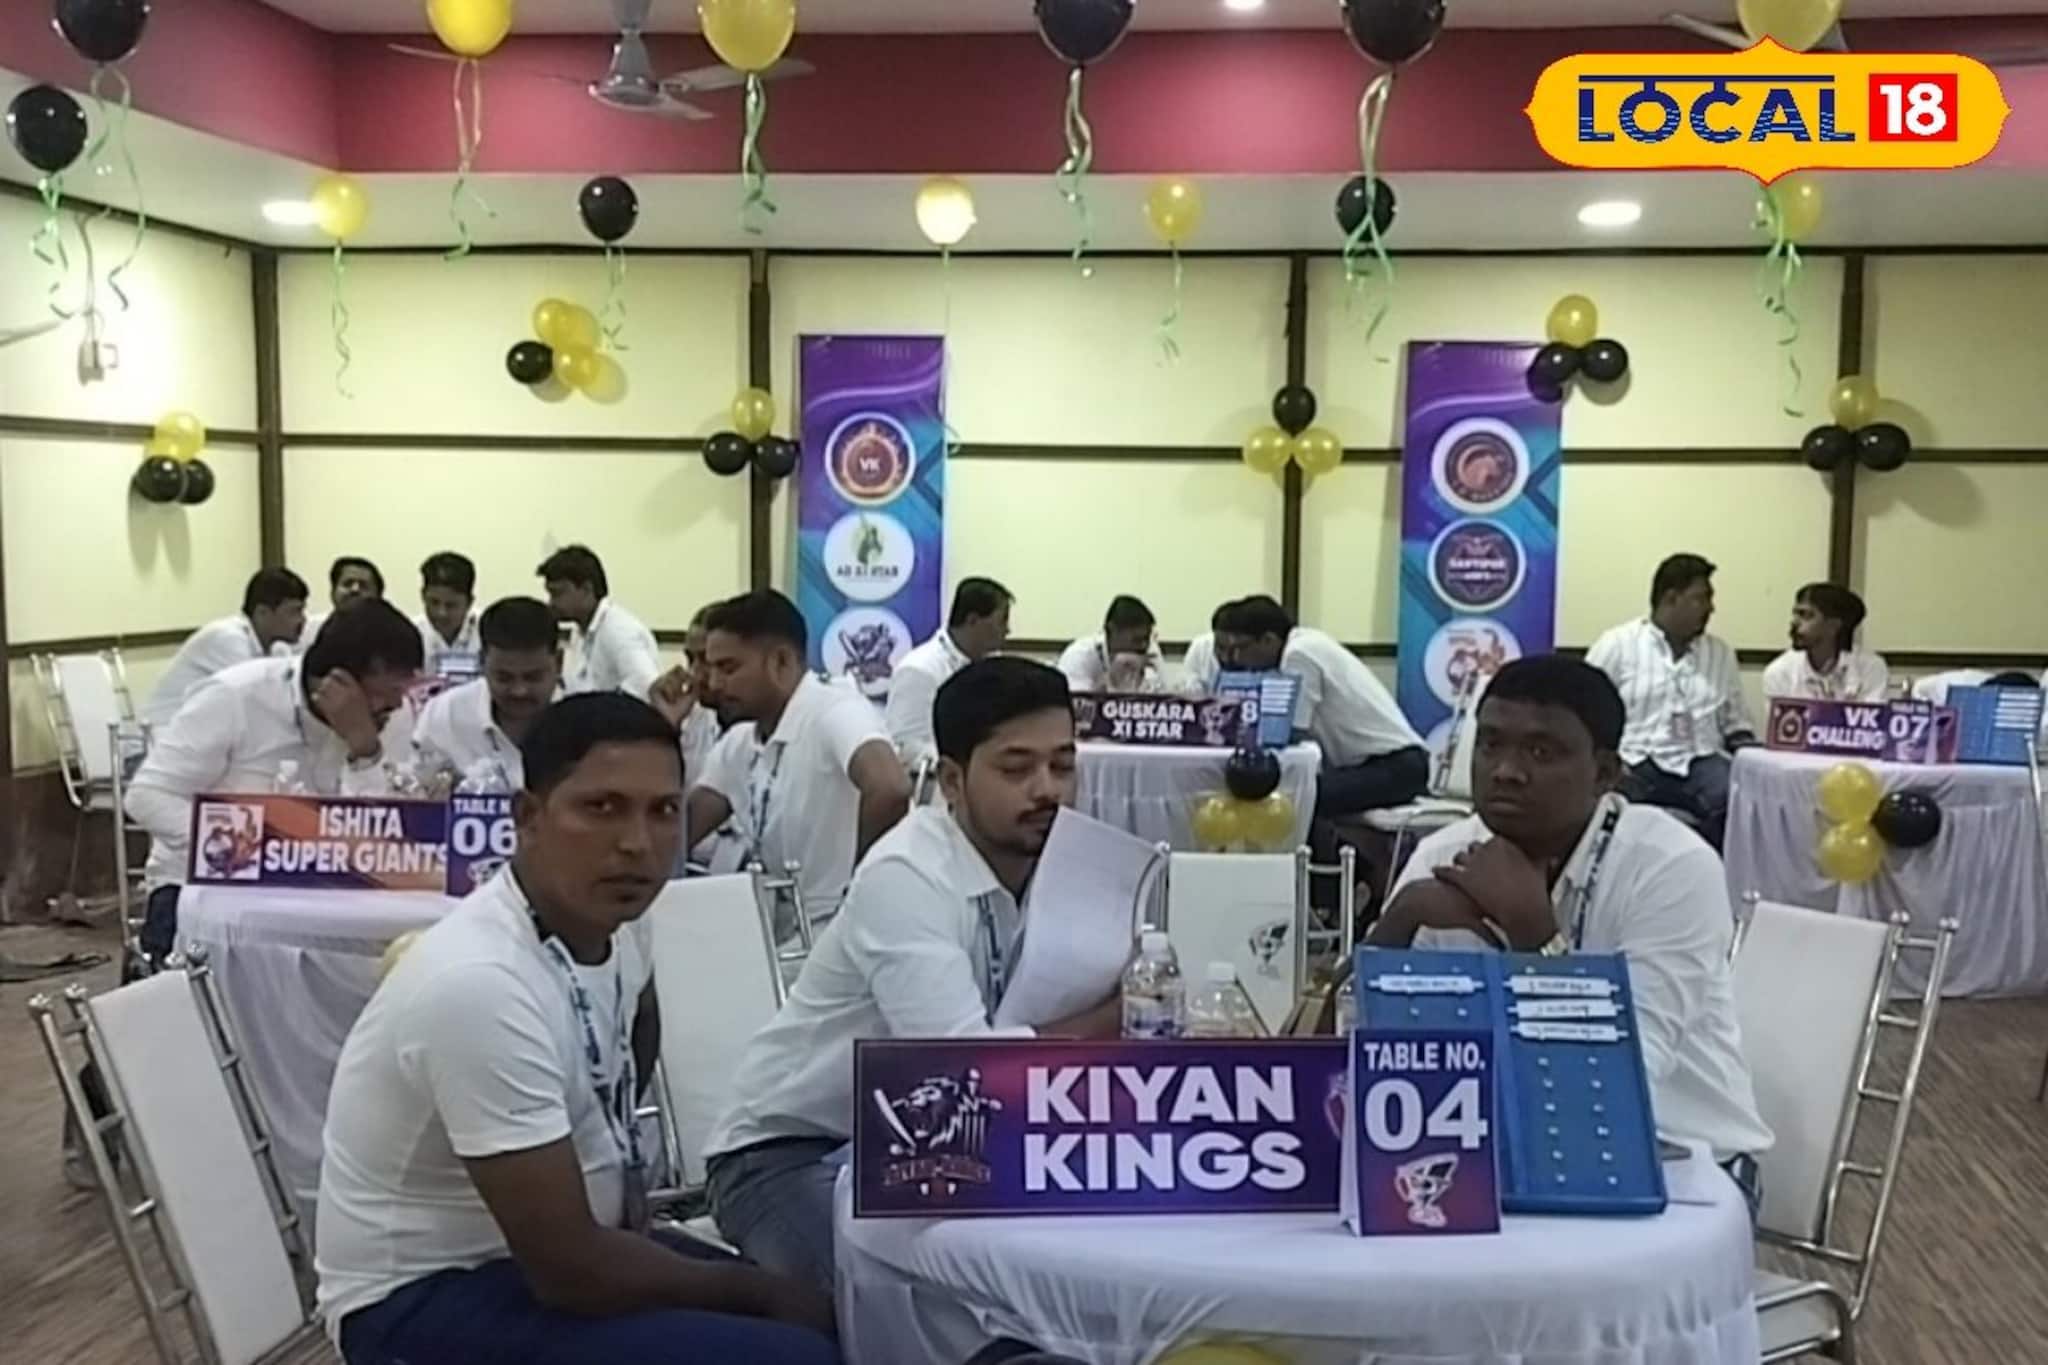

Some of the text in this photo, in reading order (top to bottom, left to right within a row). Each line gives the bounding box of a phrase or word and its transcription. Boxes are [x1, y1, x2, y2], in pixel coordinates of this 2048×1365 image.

[1102, 700, 1196, 722] GUSKARA
[1844, 707, 1879, 727] VK
[1889, 714, 1930, 739] 07
[1112, 719, 1184, 740] XI STAR
[452, 797, 497, 814] TABLE
[319, 805, 404, 838] ISHITA
[452, 816, 518, 856] 06
[264, 838, 347, 873] SUPER
[1364, 1042, 1486, 1071] TABLE NO.
[1026, 1065, 1297, 1124] KIYAN
[1364, 1077, 1489, 1152] 04
[1025, 1131, 1307, 1193] KINGS
